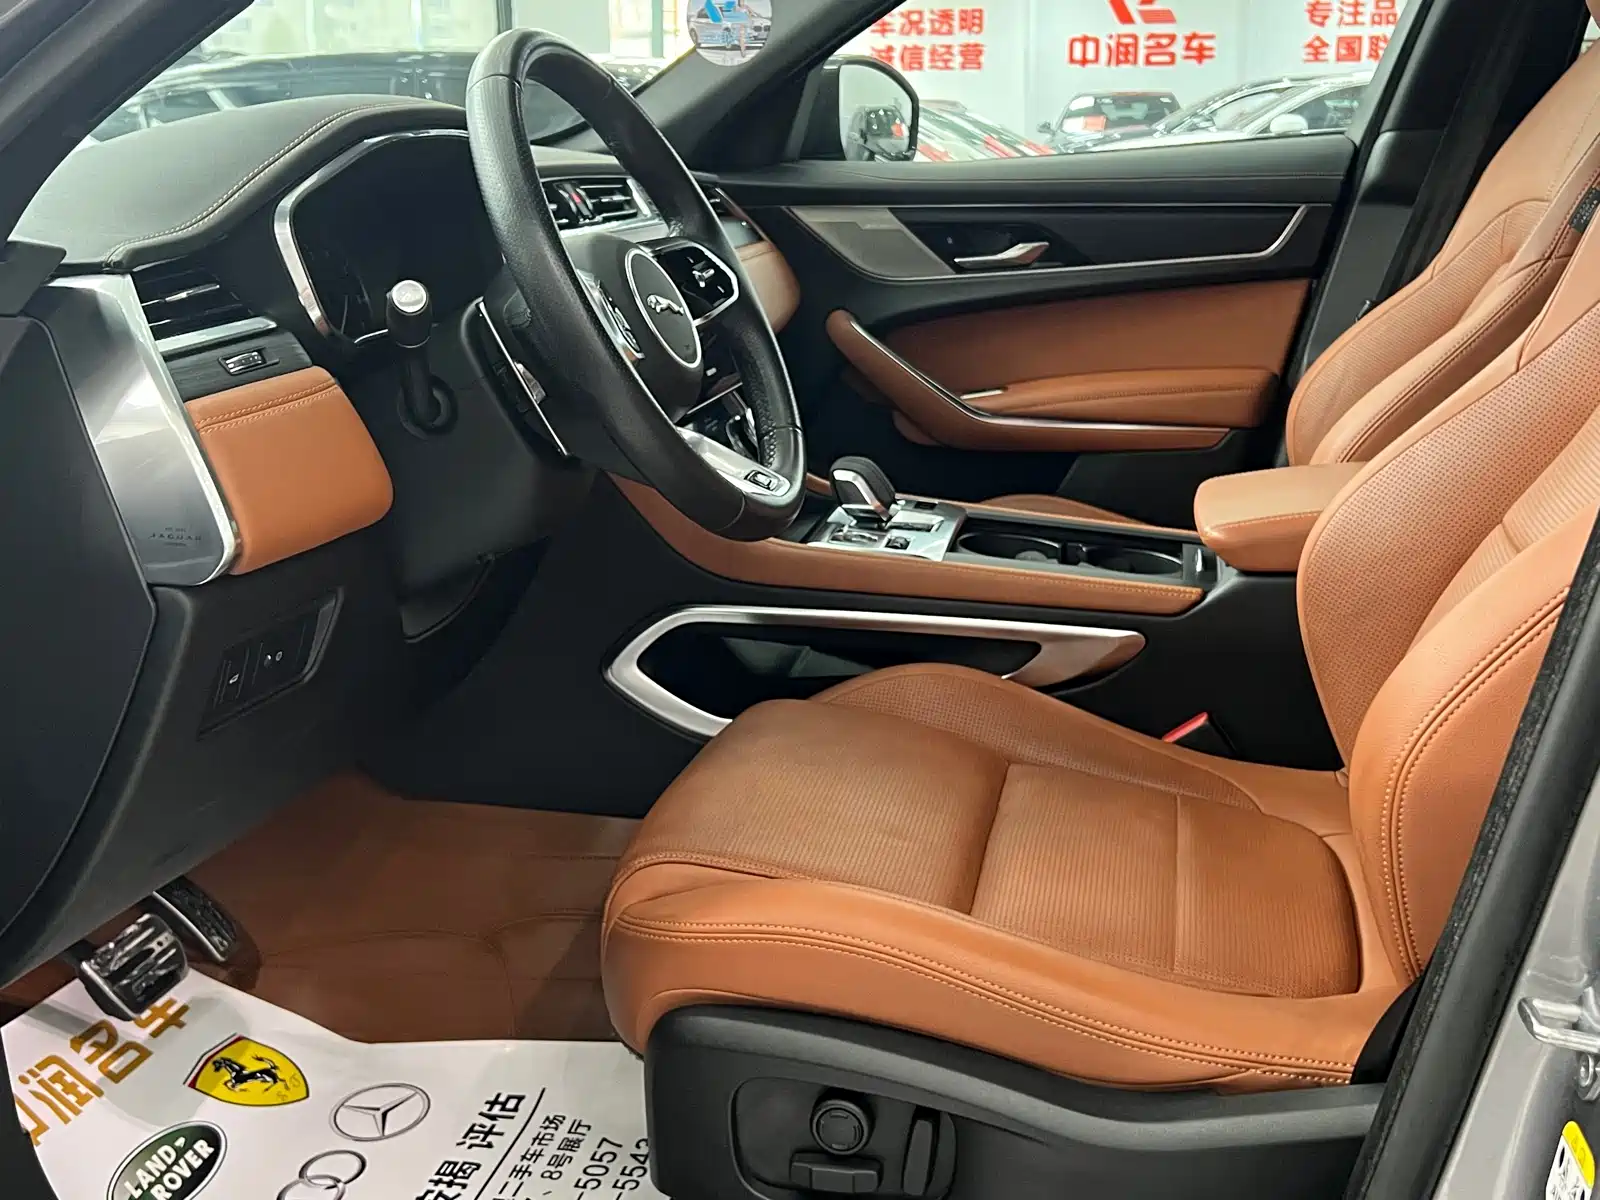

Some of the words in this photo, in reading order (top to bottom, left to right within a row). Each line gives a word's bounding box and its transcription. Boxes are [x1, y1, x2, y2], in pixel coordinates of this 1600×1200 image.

[1304, 0, 1398, 28] 专注品
[1067, 31, 1216, 68] 中润名车
[455, 1092, 526, 1149] 评估
[124, 1144, 177, 1199] LAND
[150, 1139, 215, 1200] ROVER
[491, 1114, 566, 1200] 二手车市场
